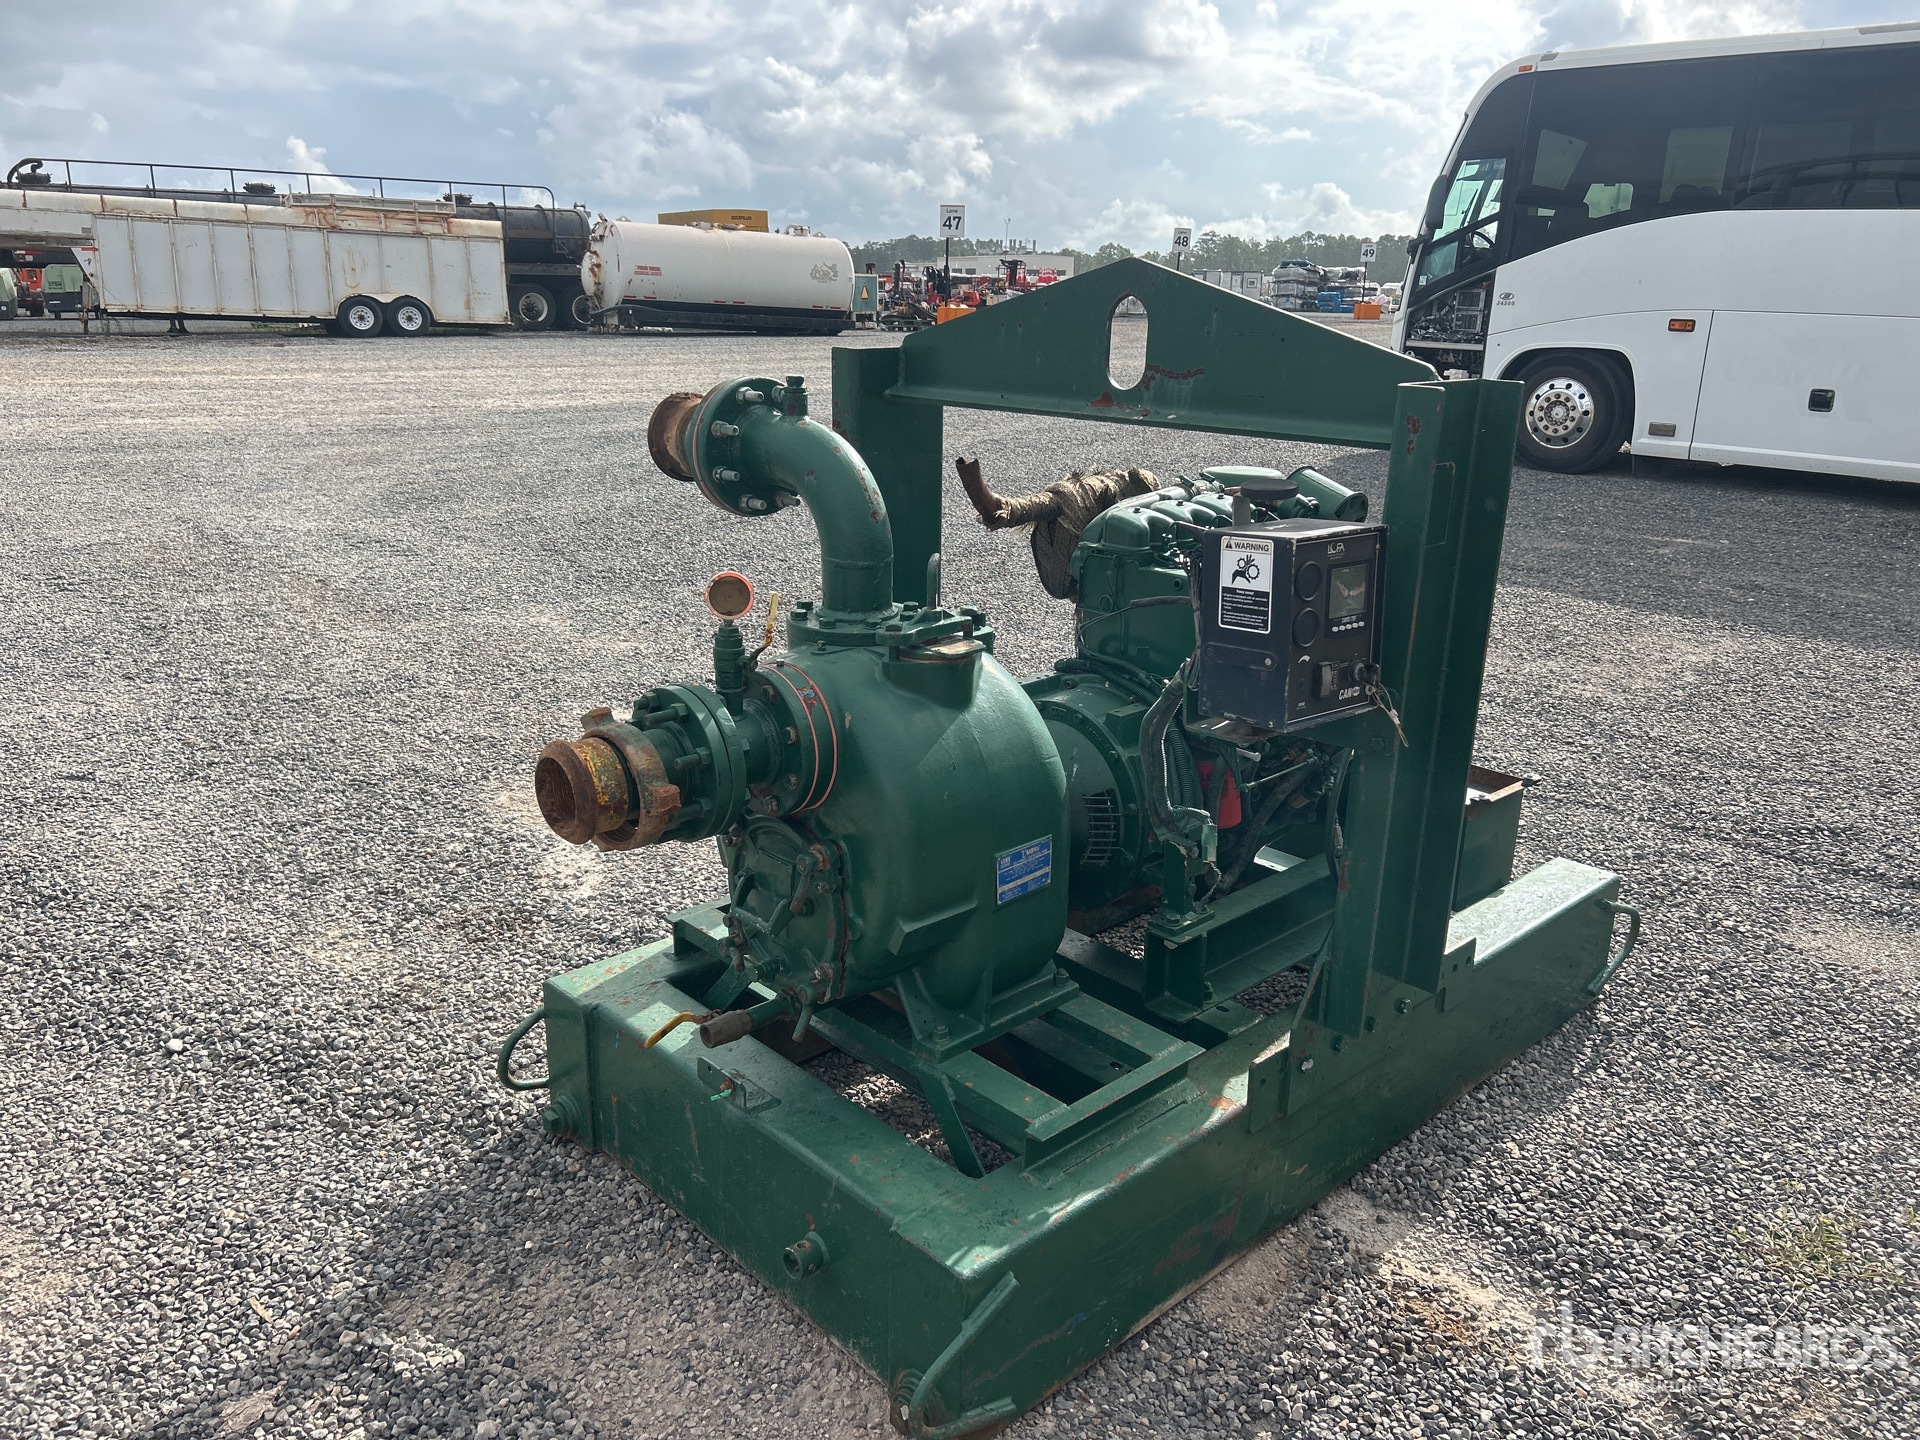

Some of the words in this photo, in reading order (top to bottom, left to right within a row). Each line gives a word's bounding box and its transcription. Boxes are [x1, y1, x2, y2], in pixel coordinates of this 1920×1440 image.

[942, 216, 962, 230] 47
[1174, 235, 1189, 247] 48
[1362, 248, 1375, 258] 49
[1234, 541, 1269, 552] WARNING
